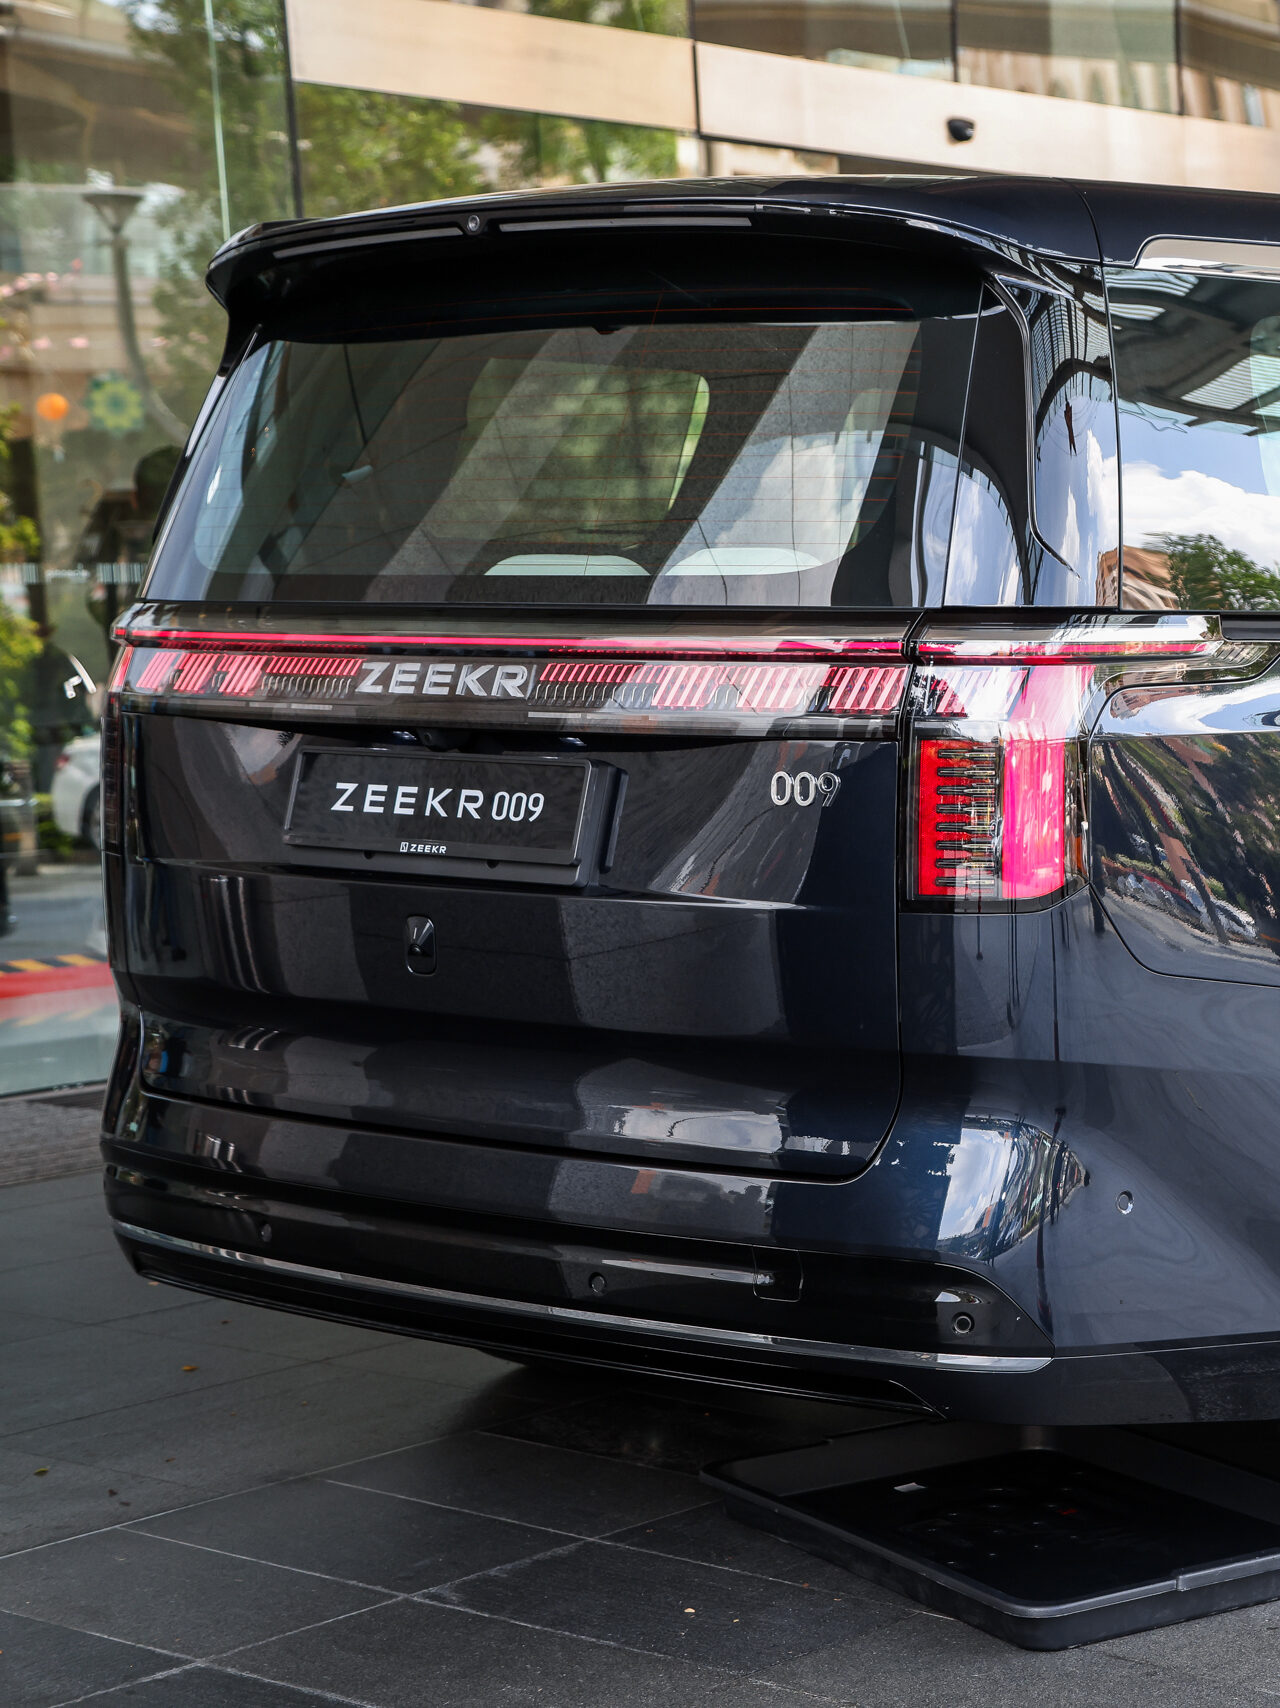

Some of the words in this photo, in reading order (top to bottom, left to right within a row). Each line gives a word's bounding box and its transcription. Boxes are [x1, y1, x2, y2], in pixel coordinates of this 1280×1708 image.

[355, 662, 528, 698] ZEEKR
[331, 782, 483, 820] ZEEKR
[491, 791, 545, 822] 009
[770, 771, 841, 807] 009
[410, 843, 447, 854] ZEEKR
